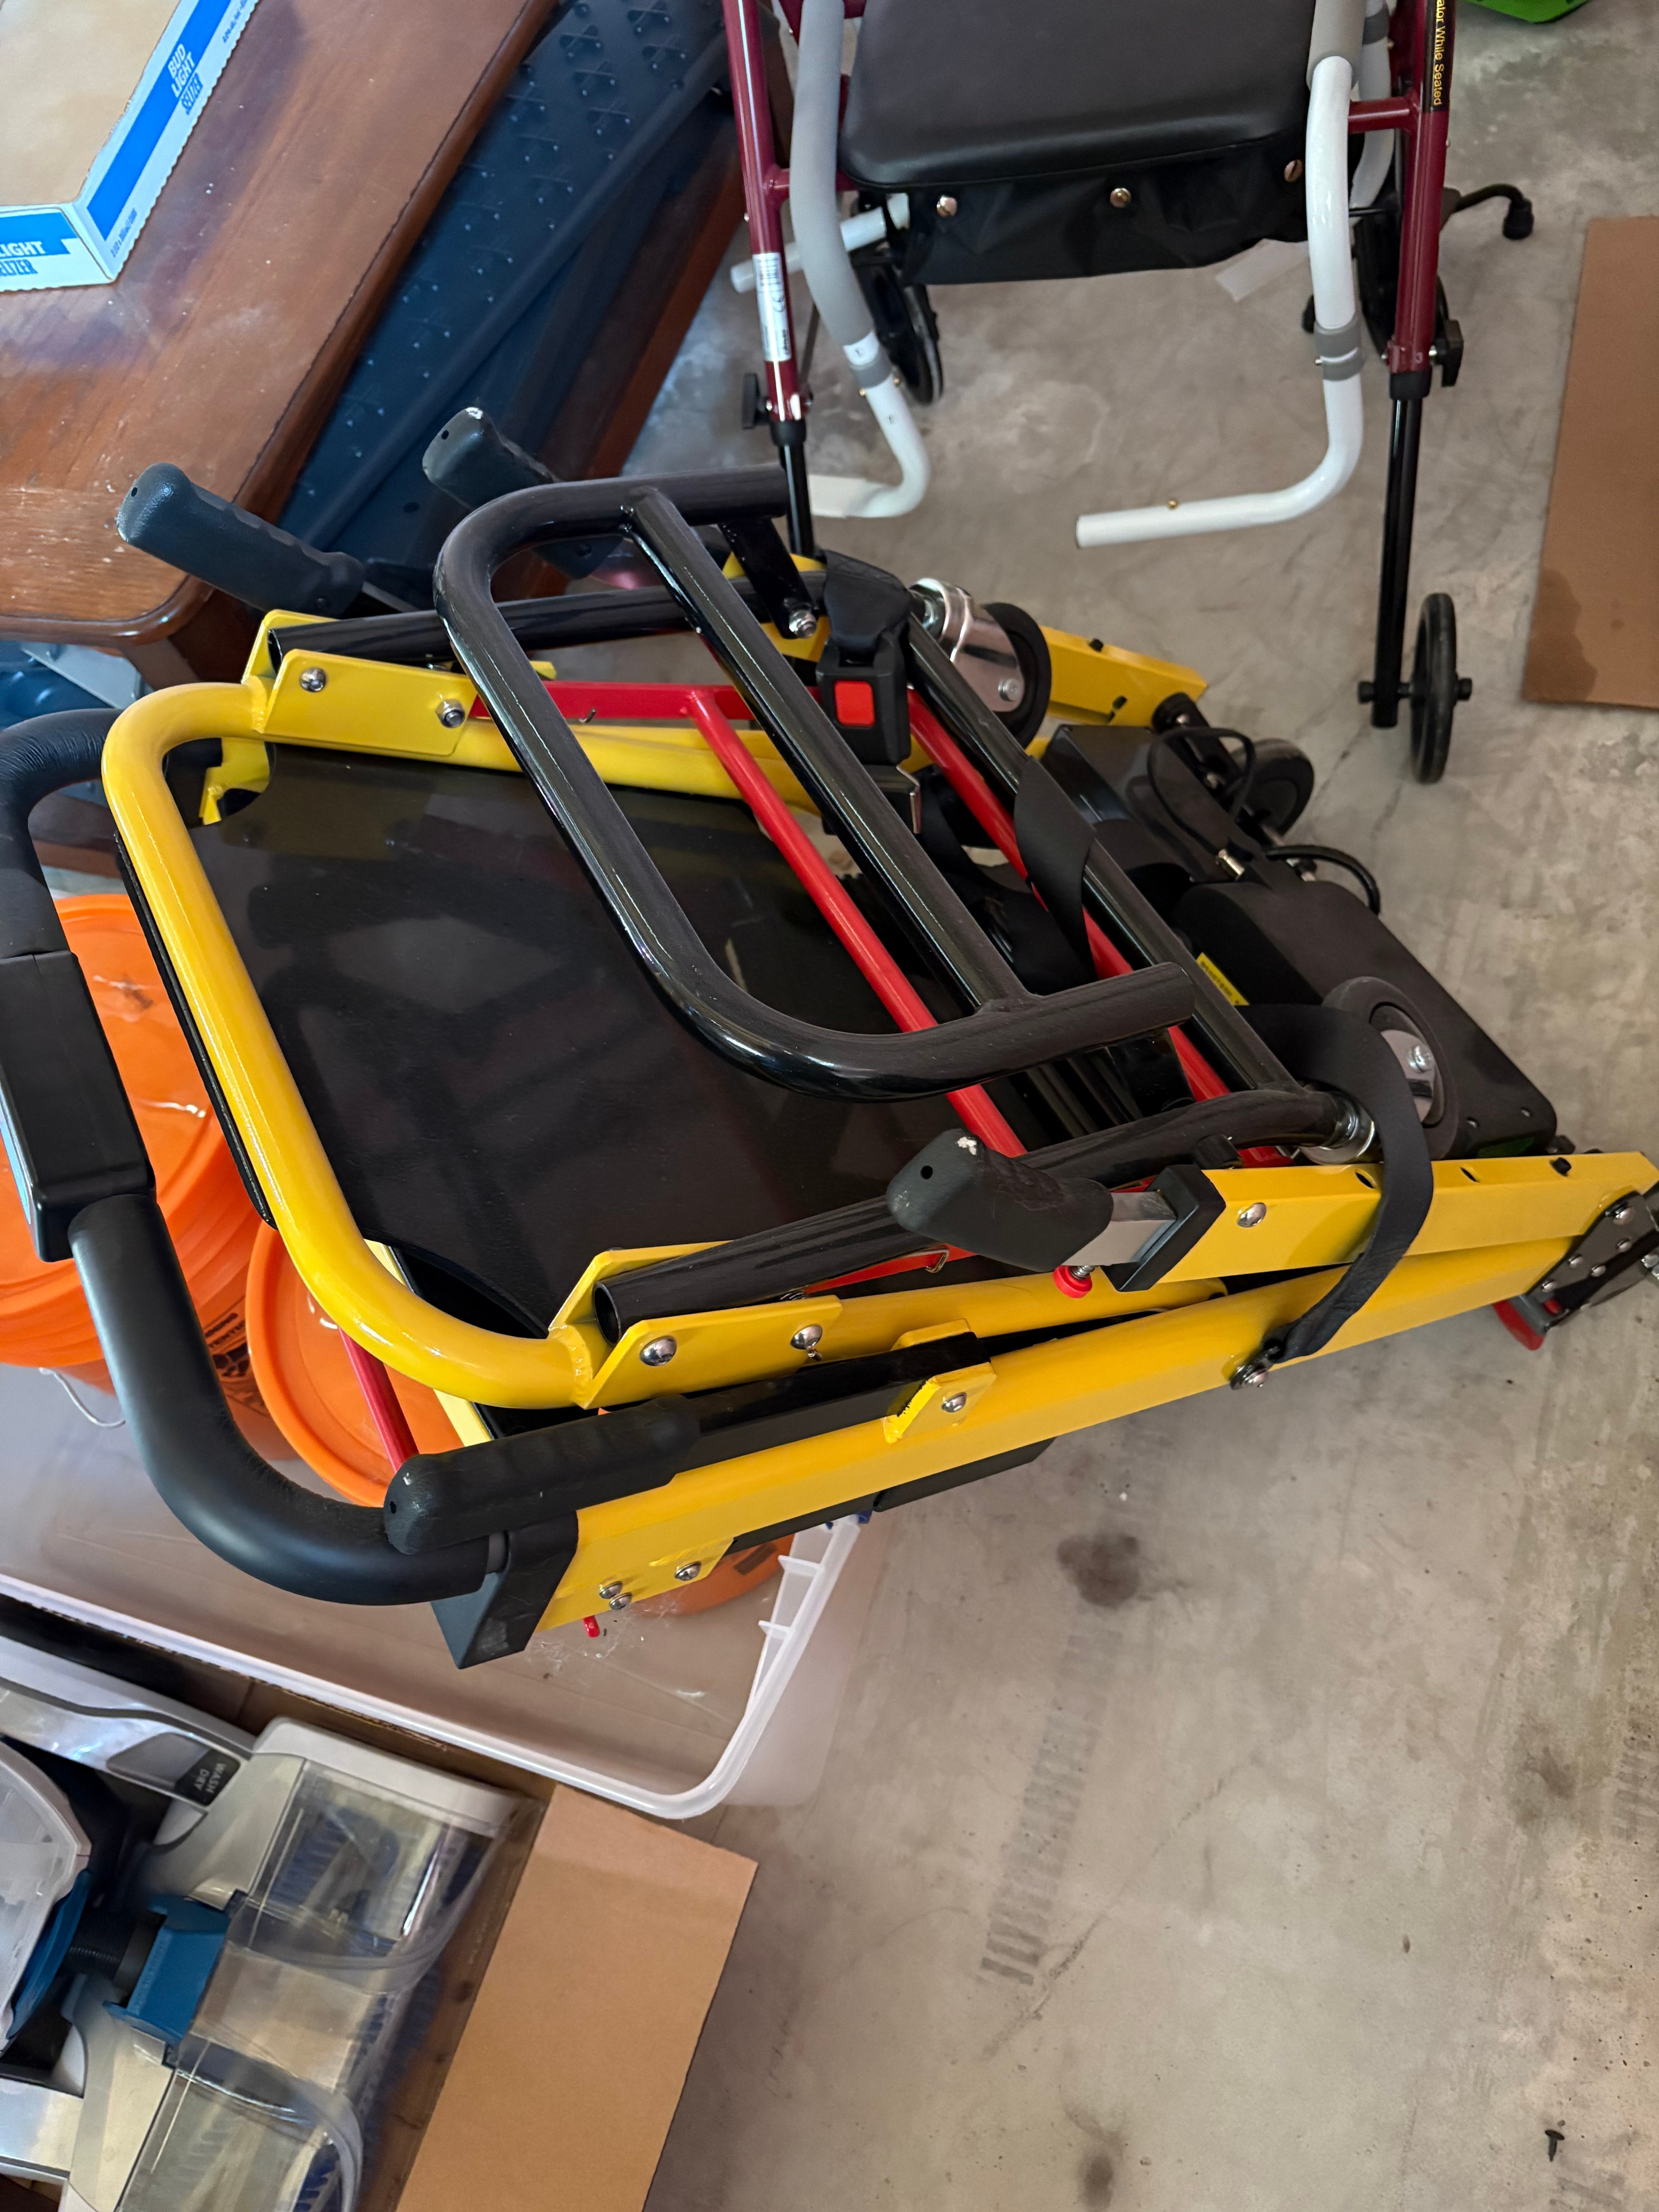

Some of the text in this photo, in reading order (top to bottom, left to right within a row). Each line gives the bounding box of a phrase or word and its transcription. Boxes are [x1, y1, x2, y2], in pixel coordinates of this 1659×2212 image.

[1435, 26, 1446, 60] While
[168, 44, 186, 79] BUD
[171, 51, 195, 98] LIGHT
[181, 72, 203, 115] SELTZER
[1434, 63, 1444, 106] Seated
[194, 1768, 210, 1790] DRY
[205, 1763, 227, 1793] WASH
